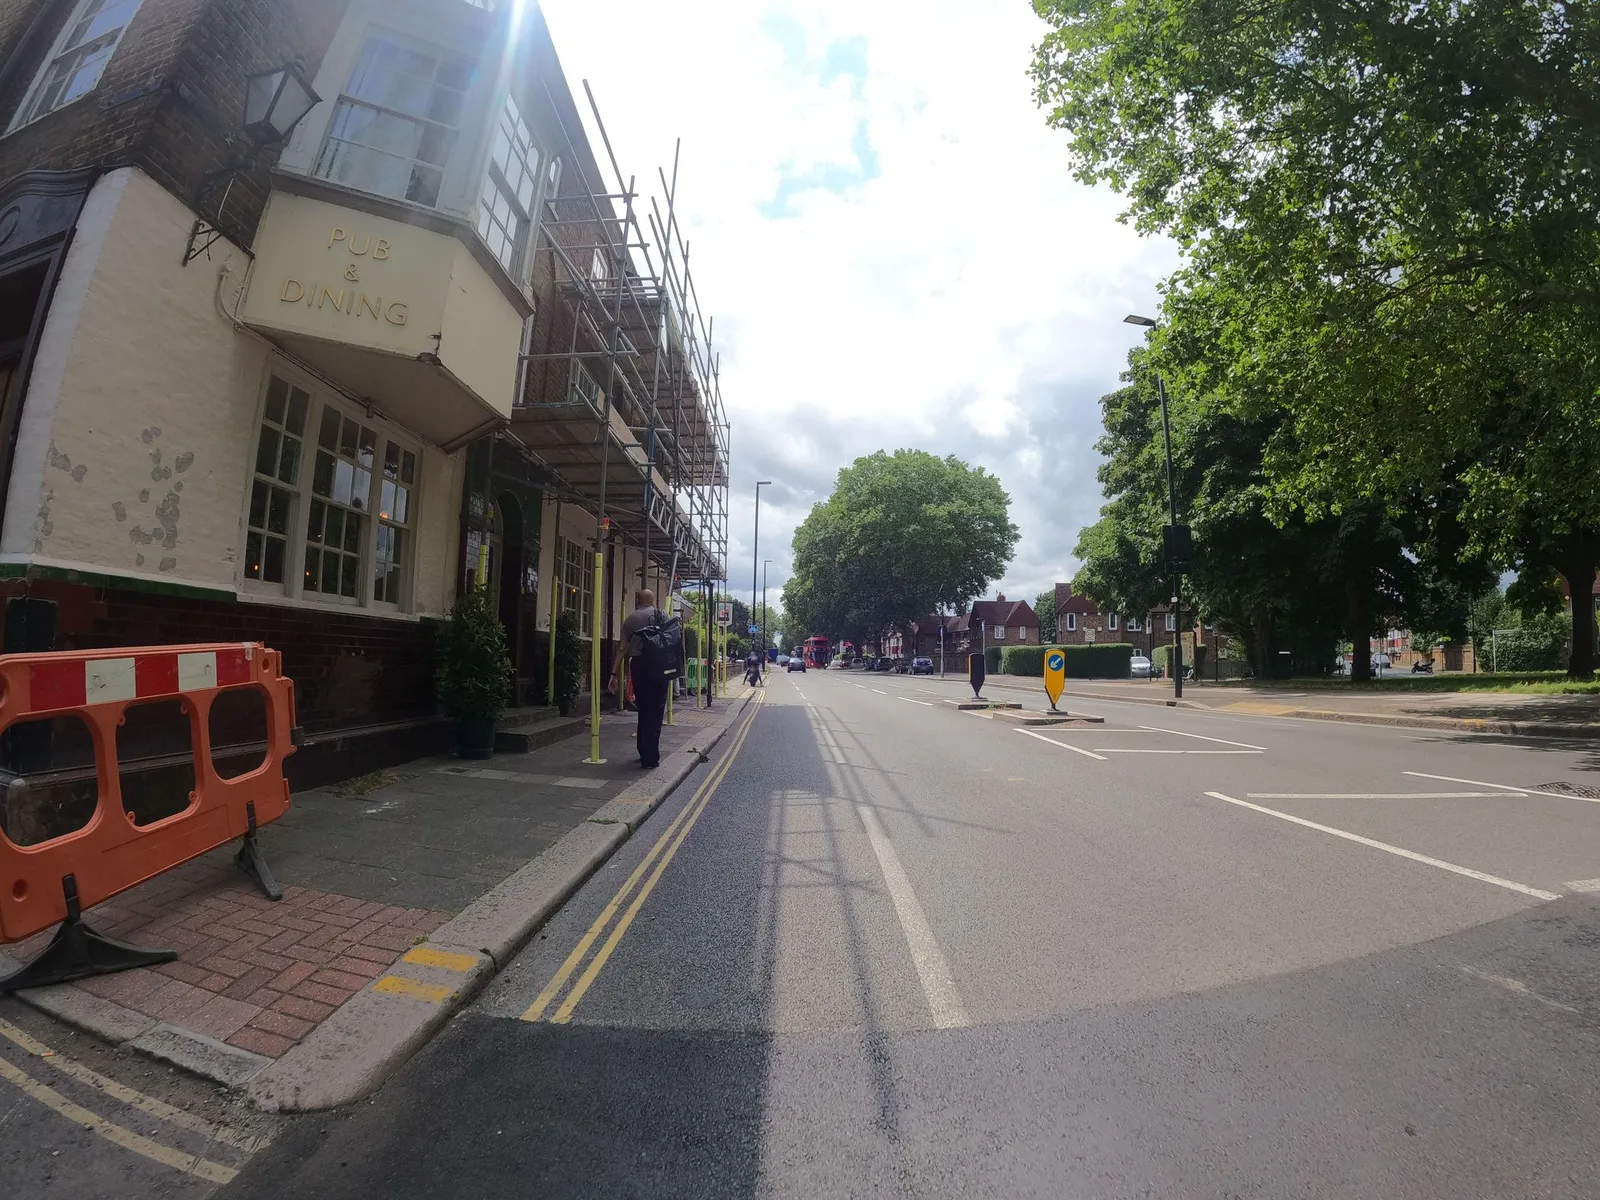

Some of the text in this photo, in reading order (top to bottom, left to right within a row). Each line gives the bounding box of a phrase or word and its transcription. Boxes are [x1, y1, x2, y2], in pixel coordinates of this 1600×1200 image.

[328, 228, 391, 260] PUB
[344, 263, 359, 282] &
[280, 278, 408, 326] DINING
